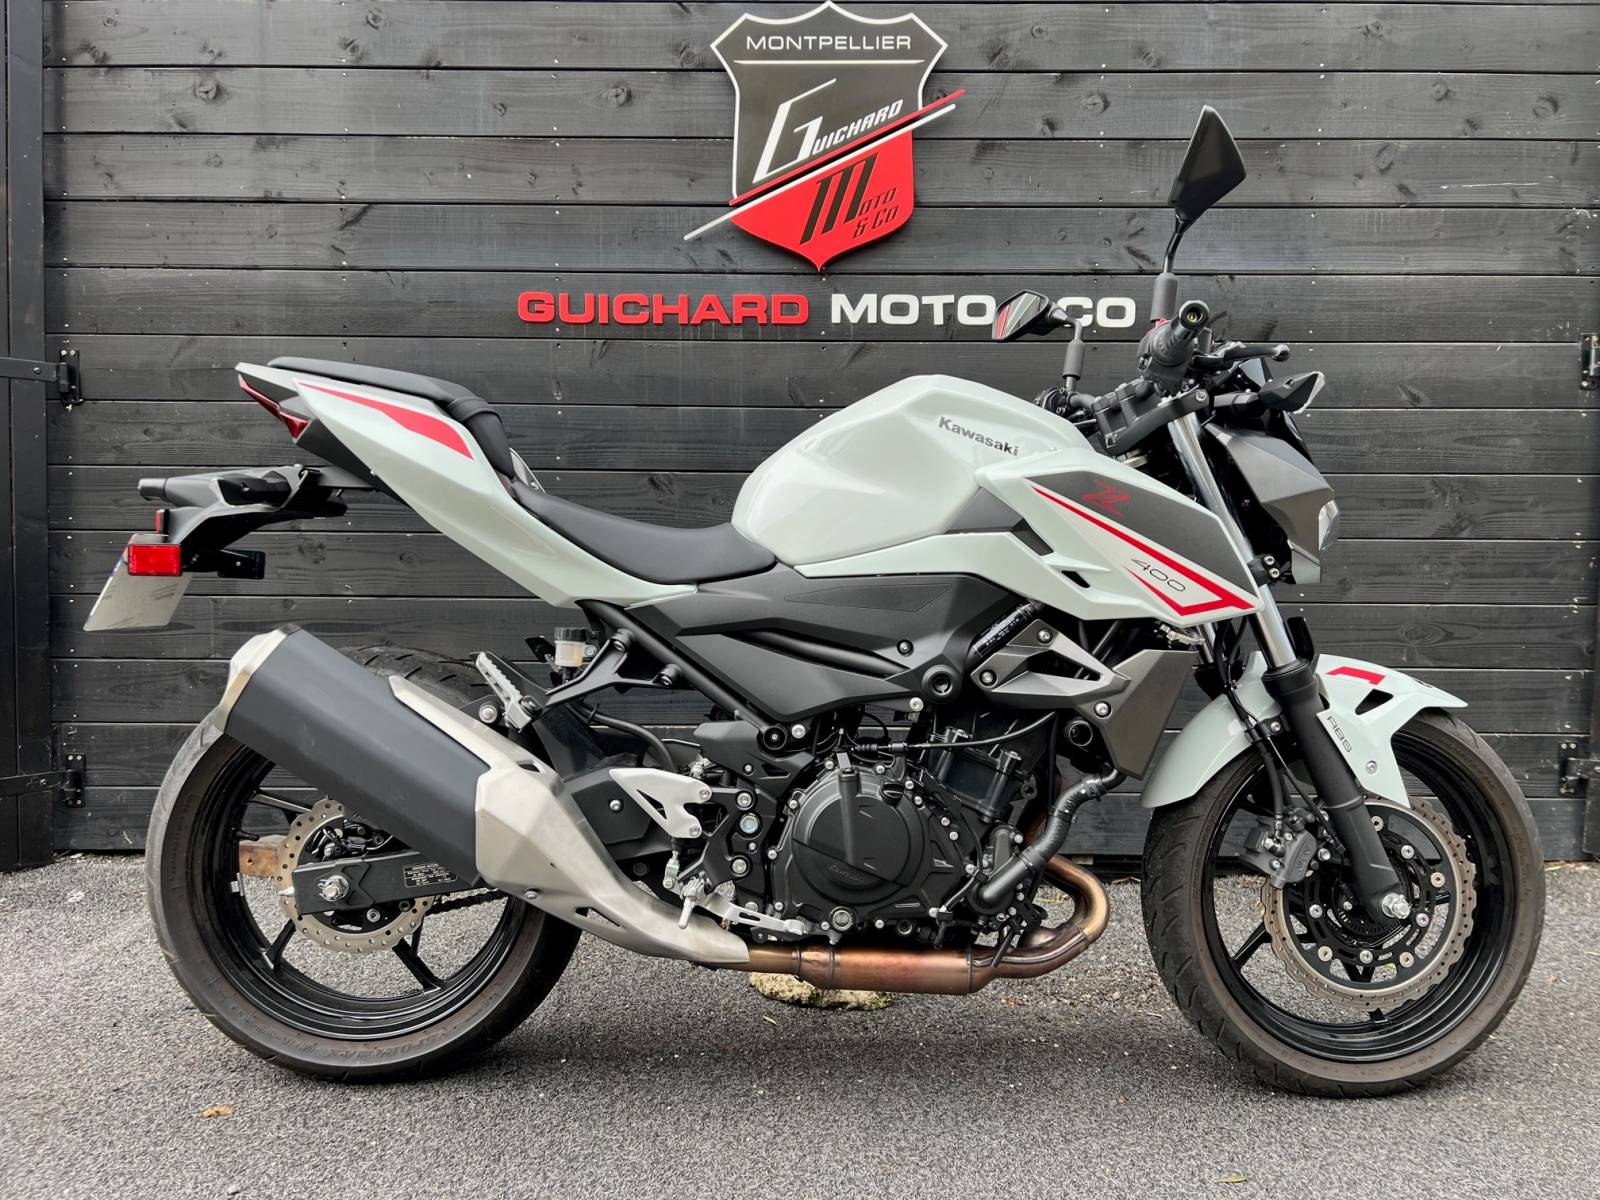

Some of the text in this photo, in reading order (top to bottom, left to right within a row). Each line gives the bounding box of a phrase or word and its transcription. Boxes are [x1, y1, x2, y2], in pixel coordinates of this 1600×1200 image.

[746, 36, 912, 50] MONTPELLIER
[752, 78, 904, 184] GUICHARD
[872, 206, 899, 229] CO
[517, 291, 1137, 328] GUICHARD MOTO CO
[938, 416, 1019, 457] Kawasaki
[1131, 558, 1186, 592] 400
[1326, 715, 1353, 753] ABS
